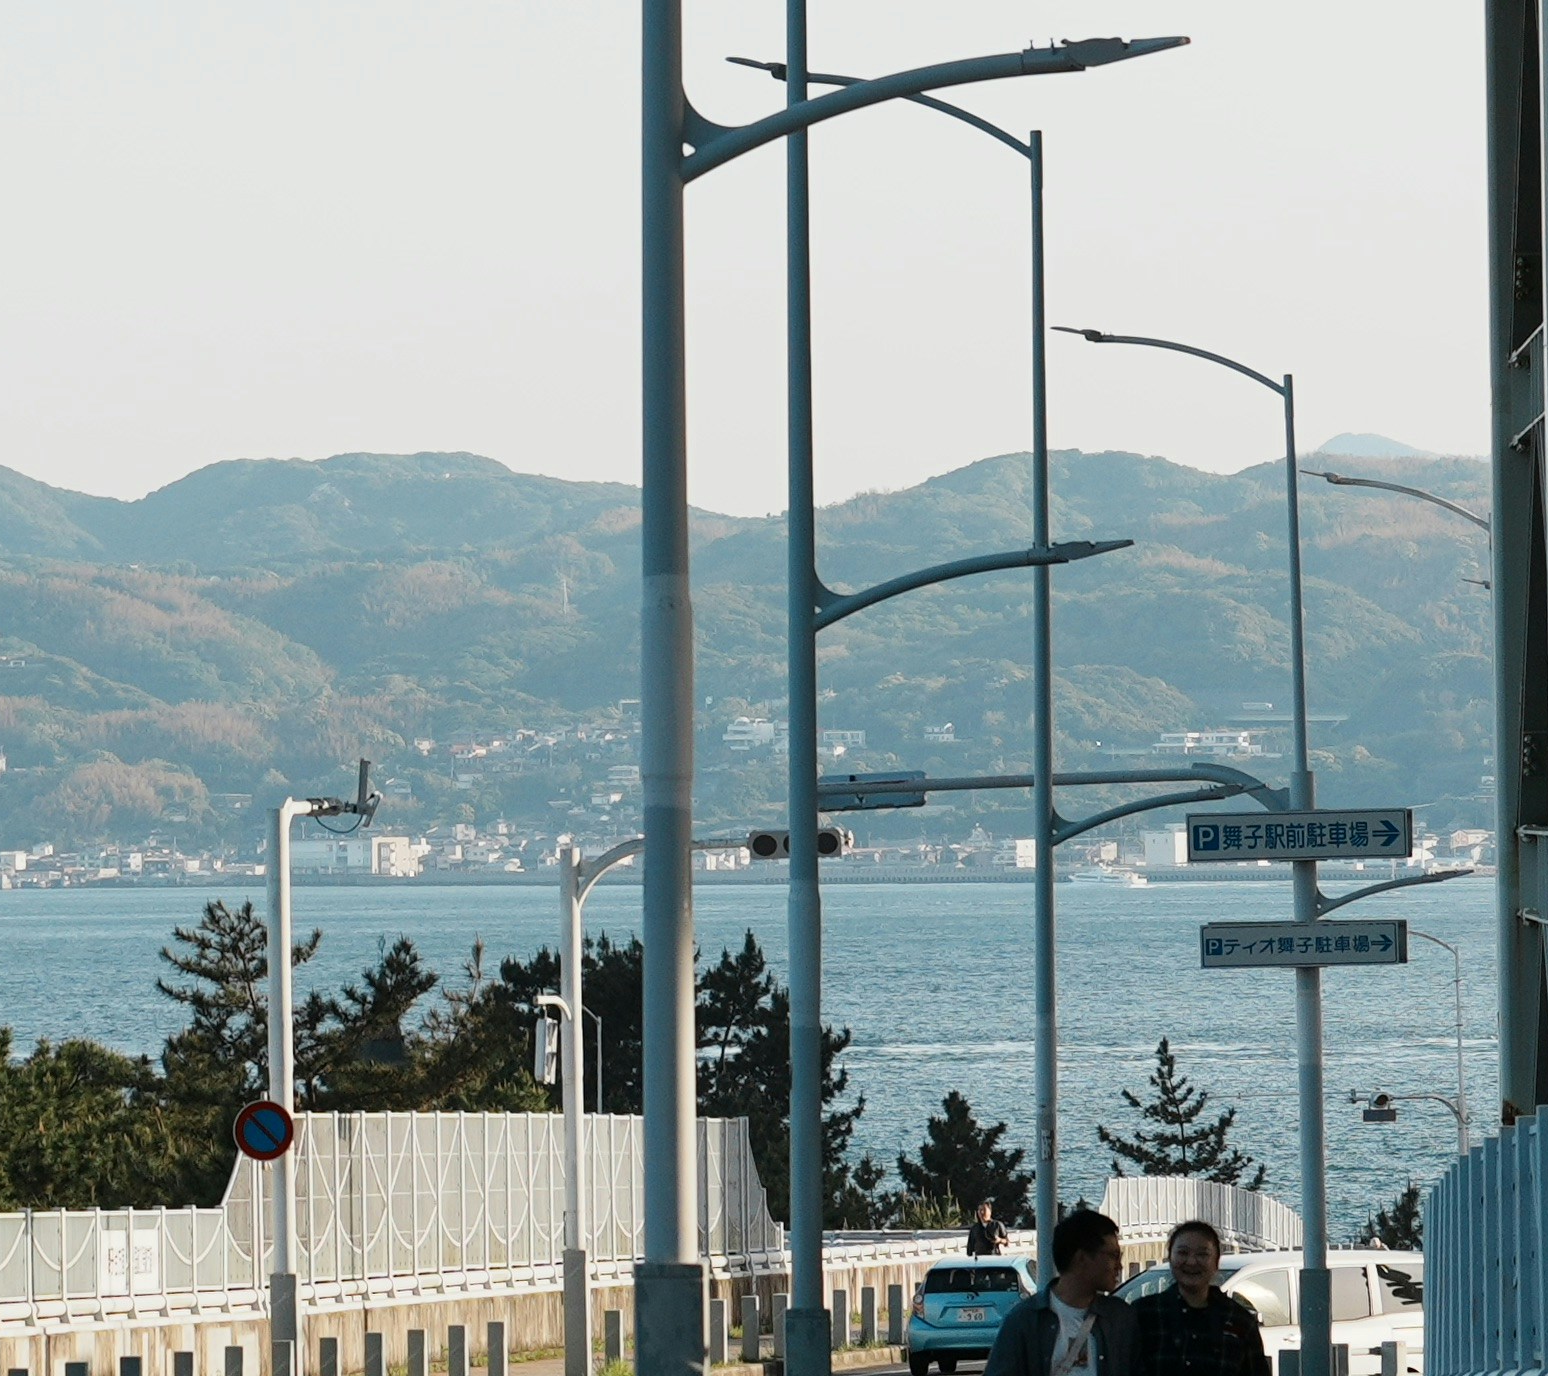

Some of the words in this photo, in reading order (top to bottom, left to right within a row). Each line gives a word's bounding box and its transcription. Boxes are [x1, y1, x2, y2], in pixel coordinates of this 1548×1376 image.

[1222, 822, 1369, 851] 舞子駅前駐車場
[1223, 935, 1370, 955] ティオ舞子駐車場
